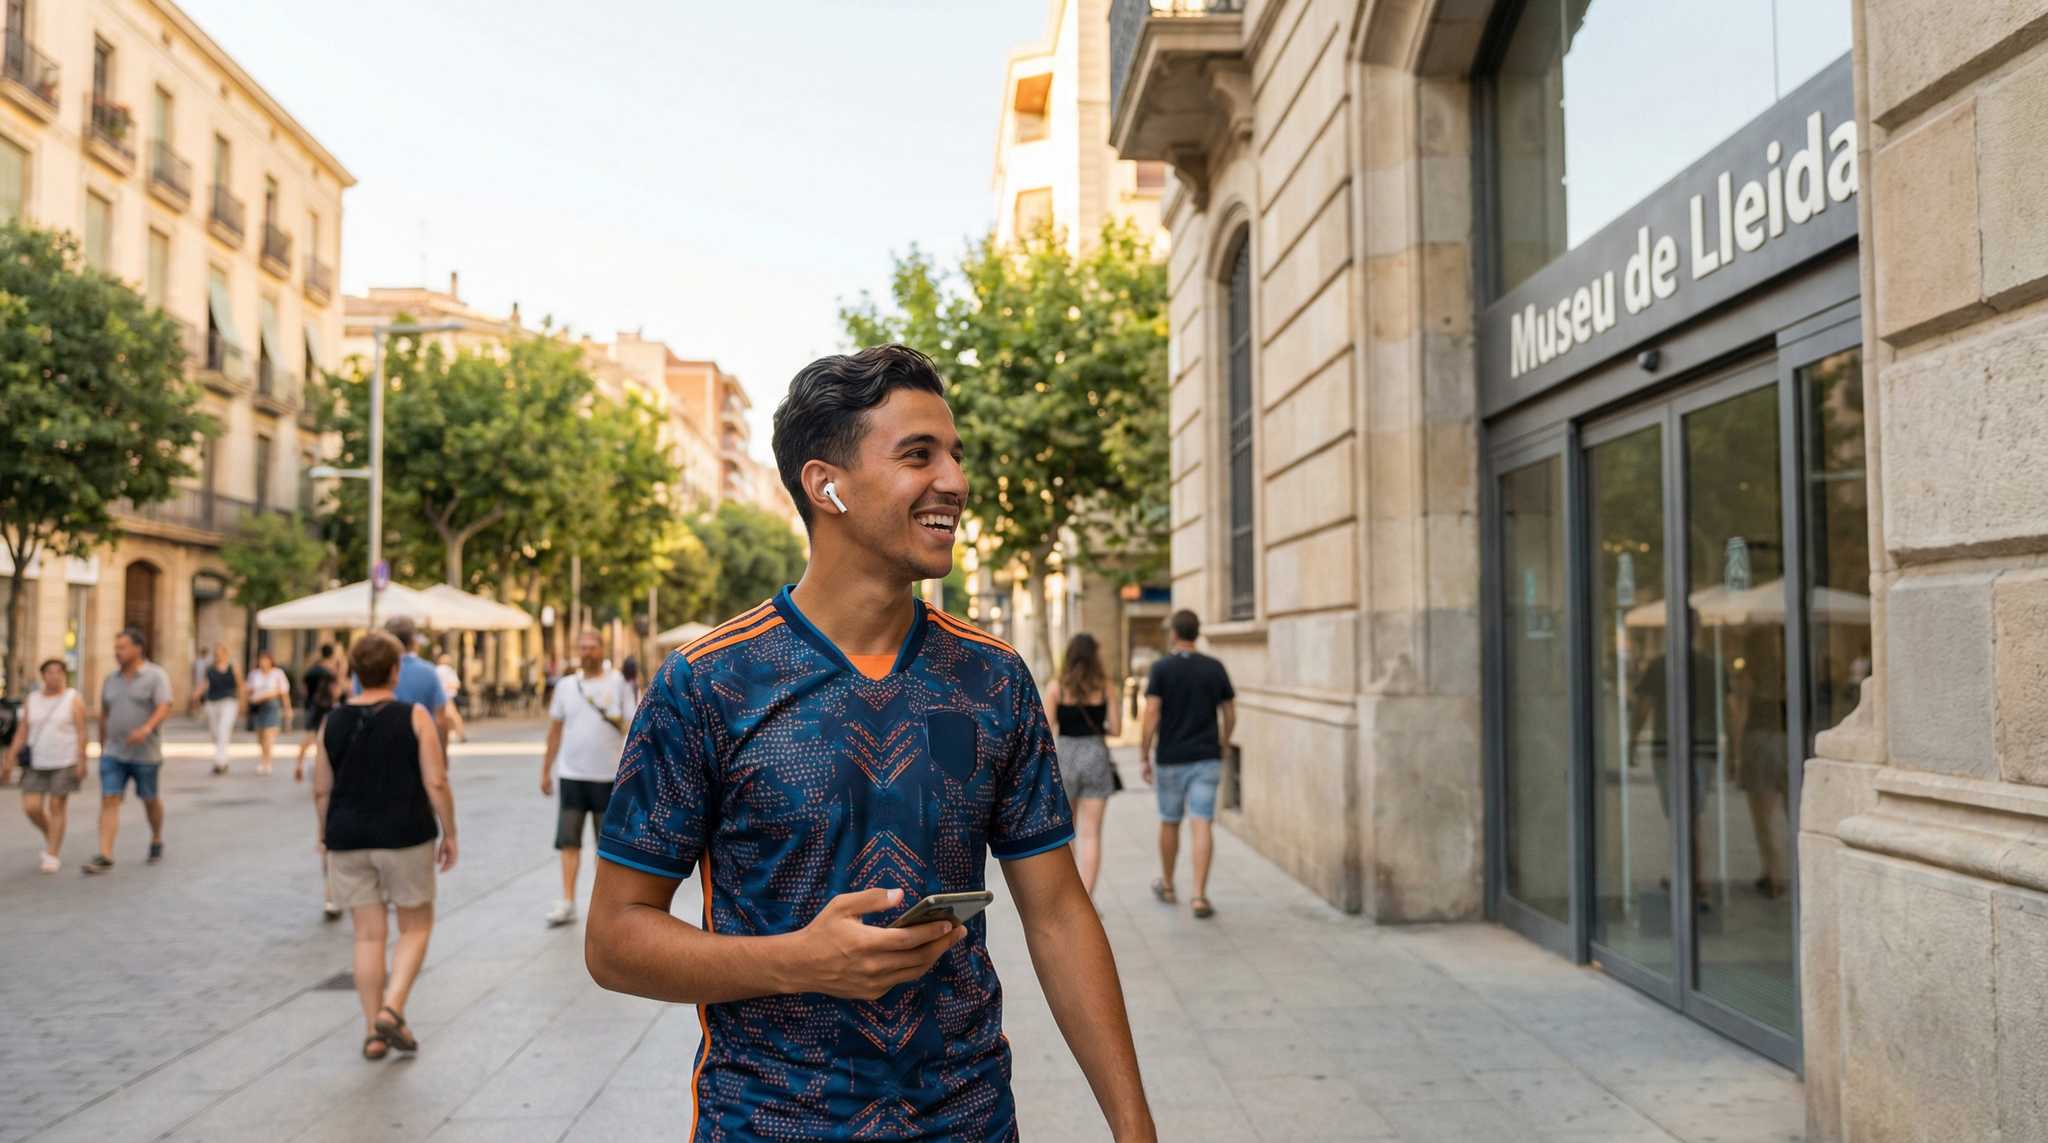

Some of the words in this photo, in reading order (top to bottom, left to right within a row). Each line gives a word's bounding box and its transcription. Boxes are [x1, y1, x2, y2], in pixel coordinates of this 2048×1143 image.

[1510, 271, 1615, 378] Museu
[1624, 225, 1678, 315] de
[1689, 111, 1858, 280] Lleida
